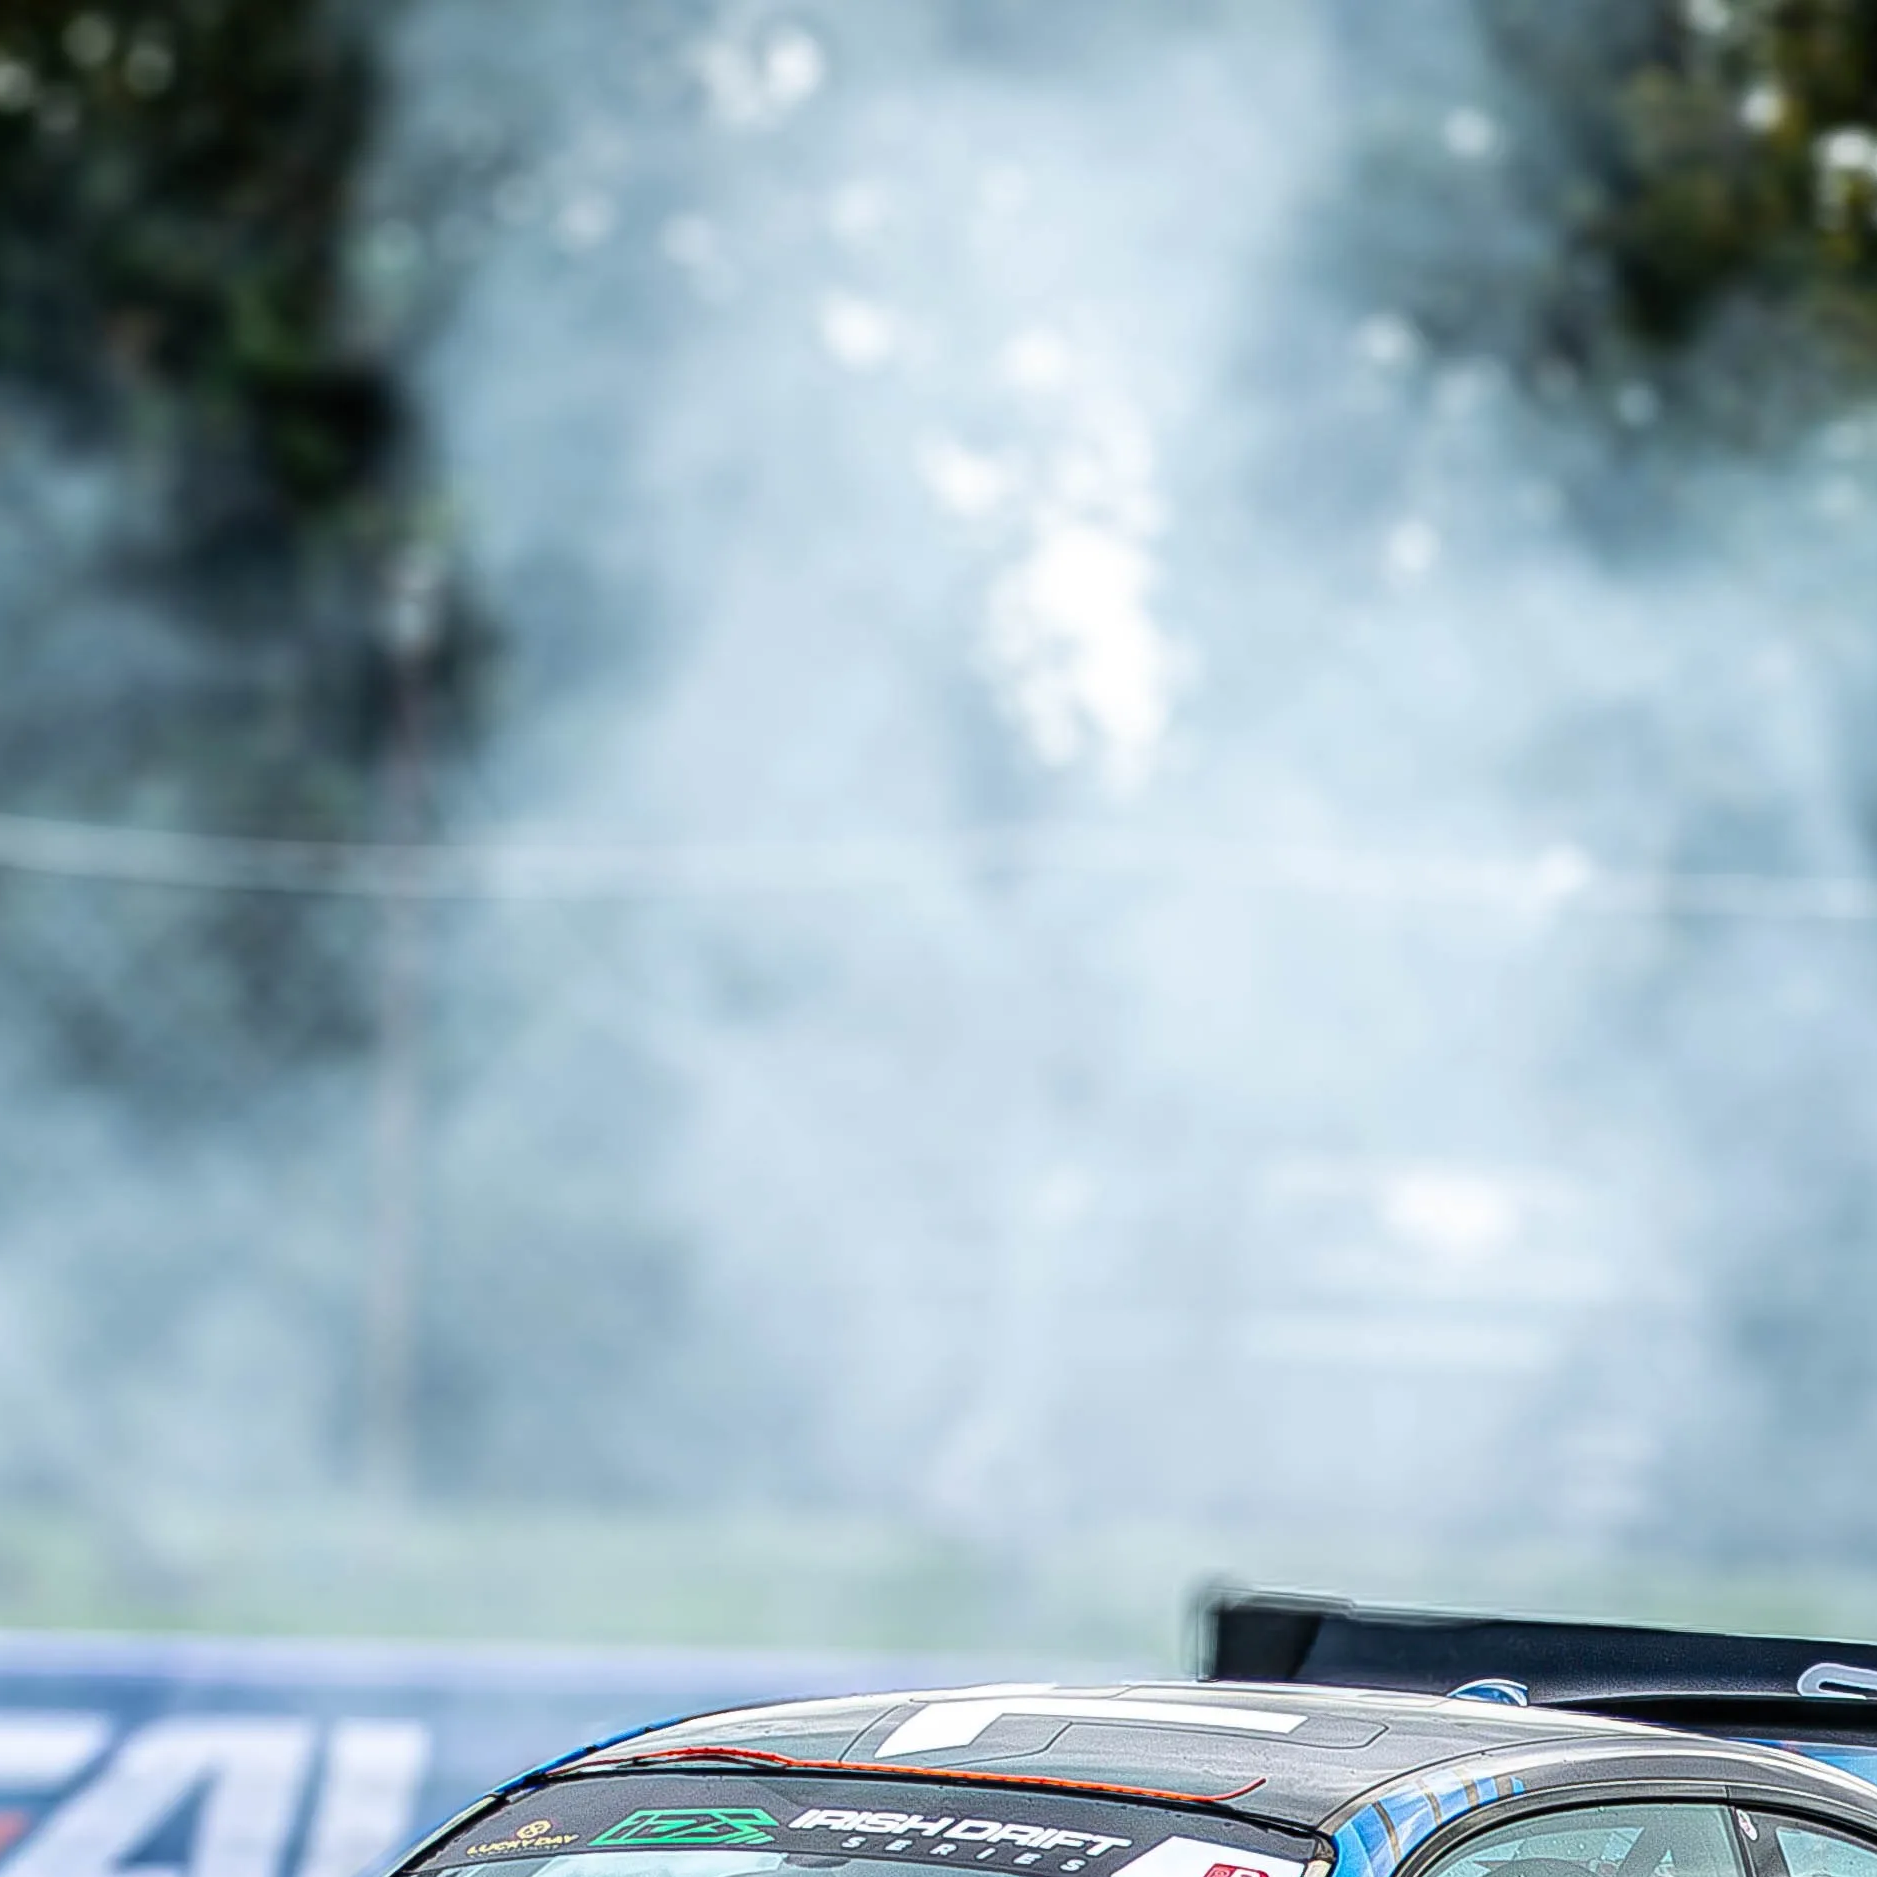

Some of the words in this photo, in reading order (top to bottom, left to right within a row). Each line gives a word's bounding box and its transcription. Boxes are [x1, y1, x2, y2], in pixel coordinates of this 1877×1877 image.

[788, 1808, 955, 1838] IRISH
[943, 1819, 1133, 1857] DRIFT
[841, 1836, 1087, 1873] SERIES
